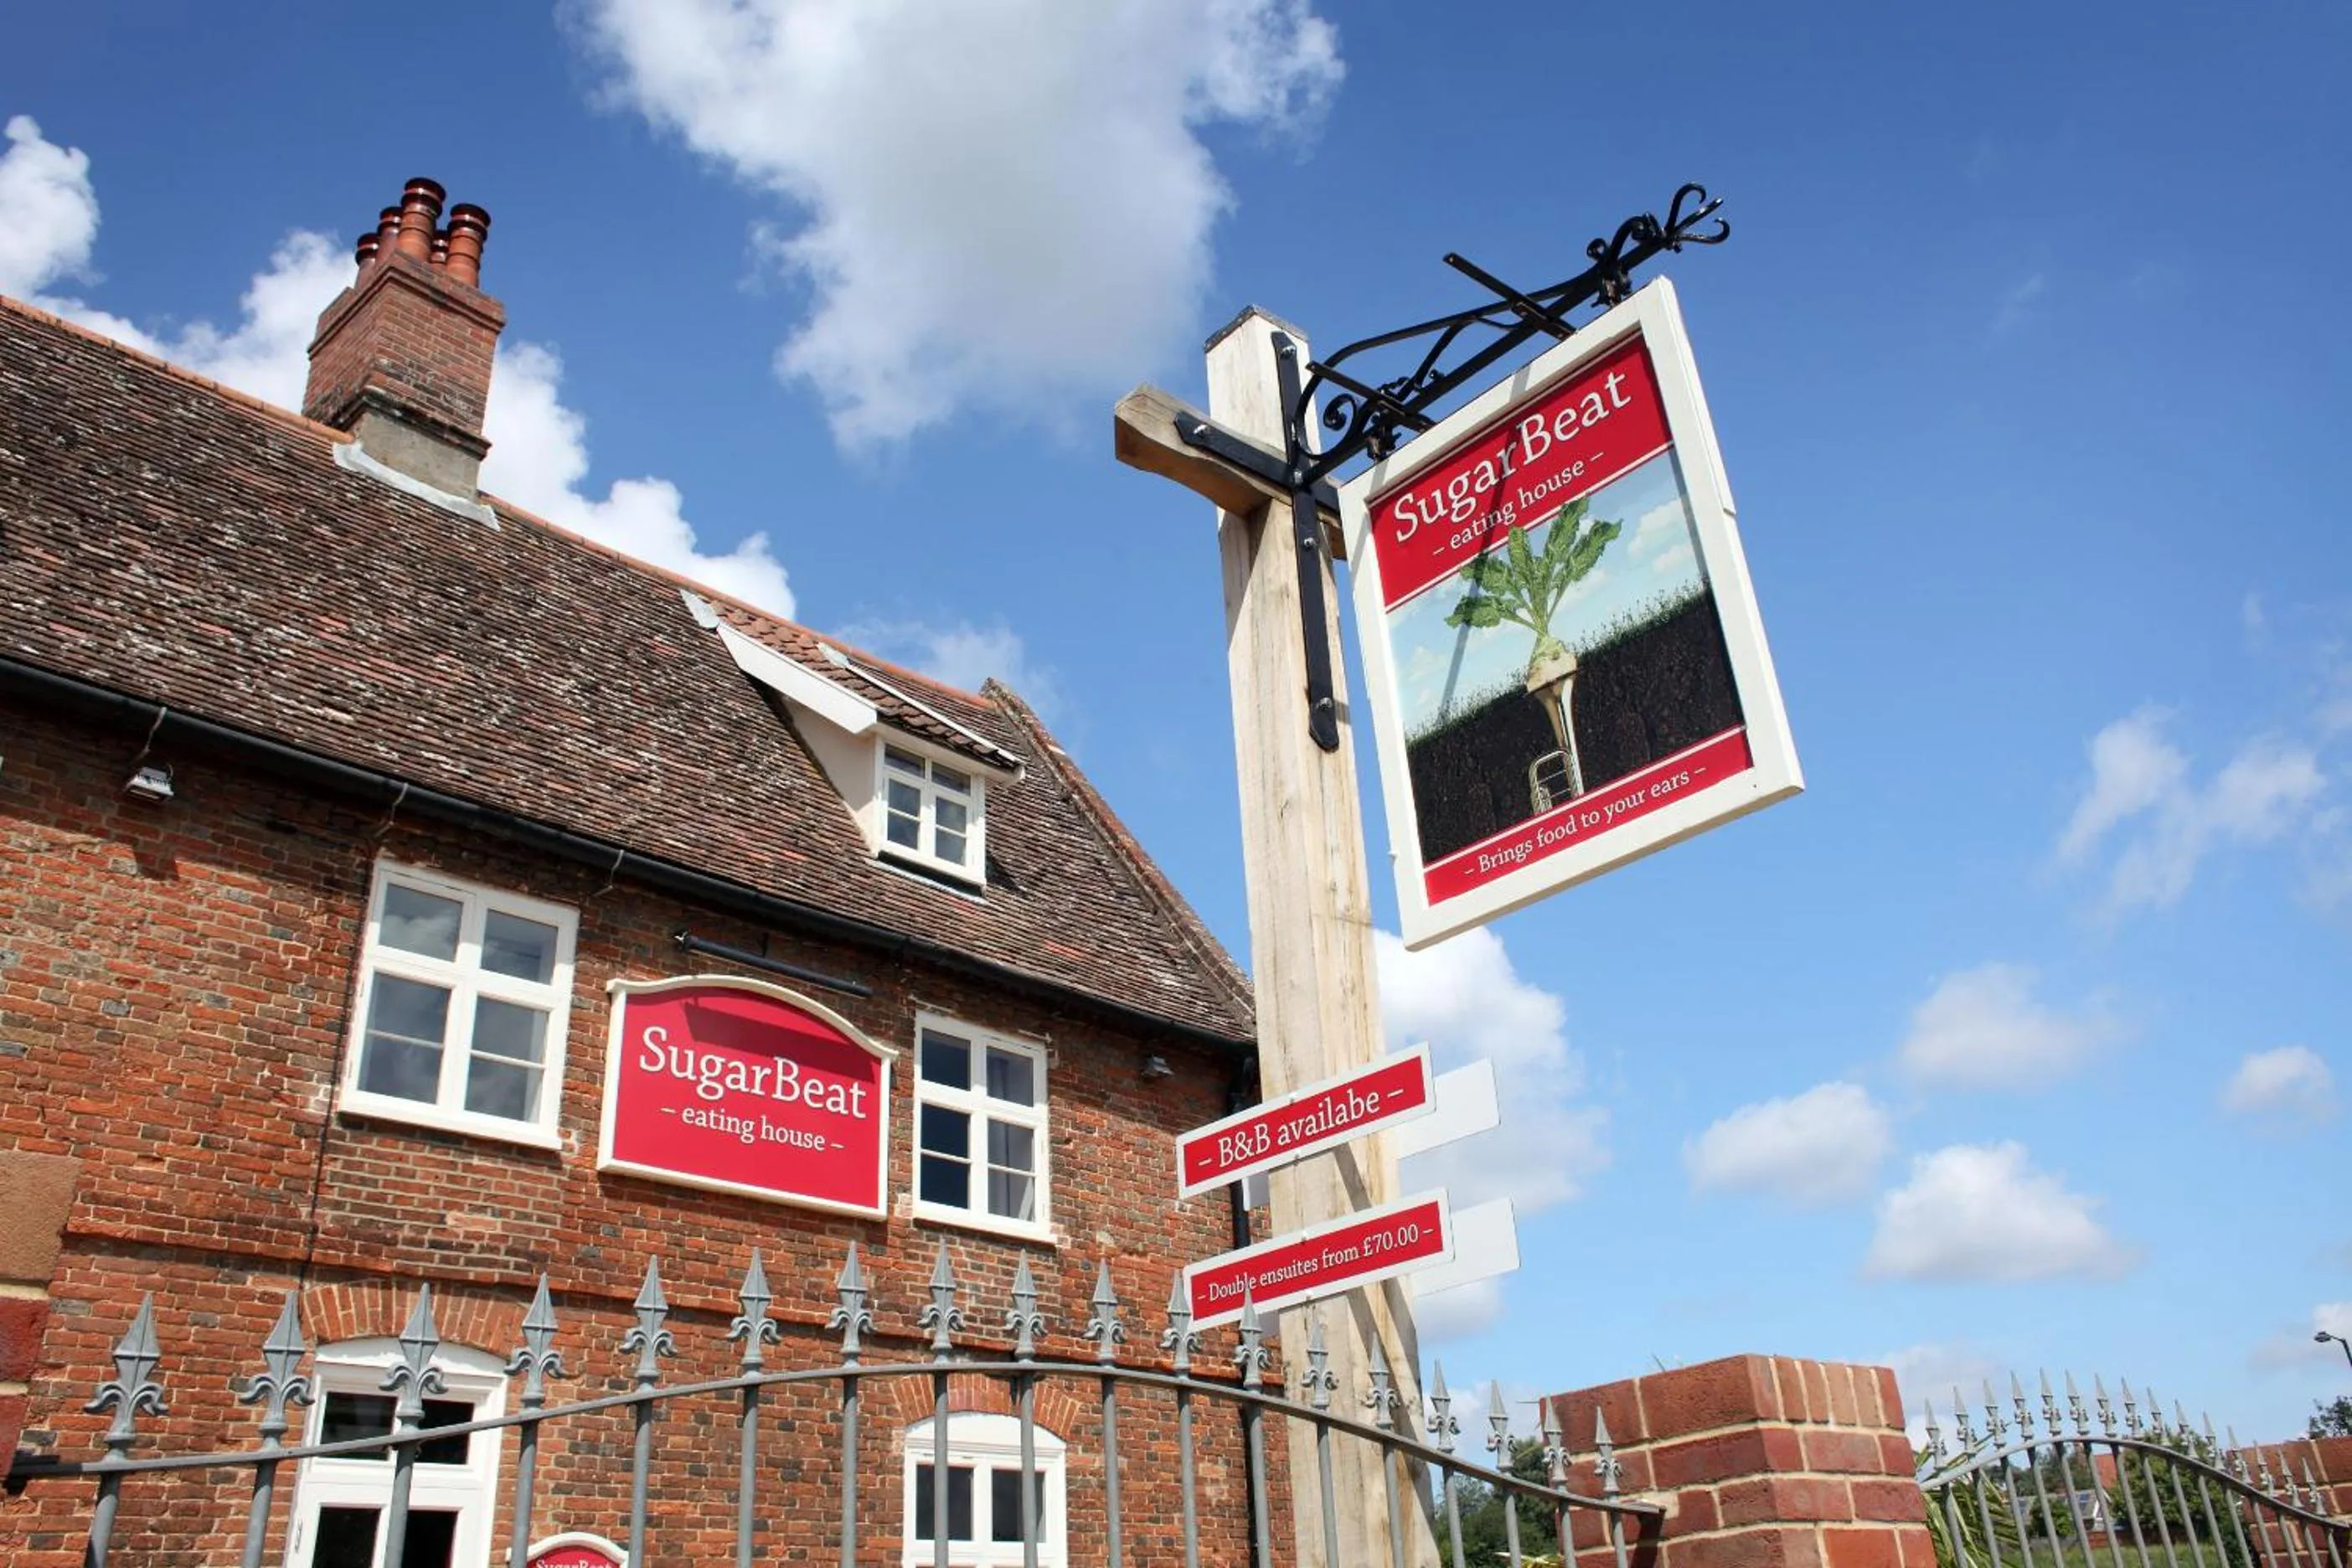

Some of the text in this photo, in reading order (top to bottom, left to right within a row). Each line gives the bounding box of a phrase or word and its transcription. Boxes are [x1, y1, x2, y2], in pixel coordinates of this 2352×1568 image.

[1394, 371, 1632, 543] SugarBeat
[1450, 501, 1514, 549] eating
[1518, 460, 1585, 509] house
[1478, 841, 1533, 874] Brings
[1535, 815, 1577, 848] food
[1581, 810, 1601, 828] to
[1605, 791, 1646, 823] your
[1650, 770, 1689, 797] ears
[639, 1026, 866, 1119] SugarBeat
[683, 1107, 755, 1144] eating
[761, 1116, 825, 1151] house
[1218, 1122, 1271, 1168] B&B
[1277, 1087, 1380, 1146] availabe
[1209, 1271, 1256, 1302] Double
[1260, 1257, 1318, 1287] ensuites
[1323, 1245, 1359, 1270] from
[1362, 1224, 1418, 1257] £70.00
